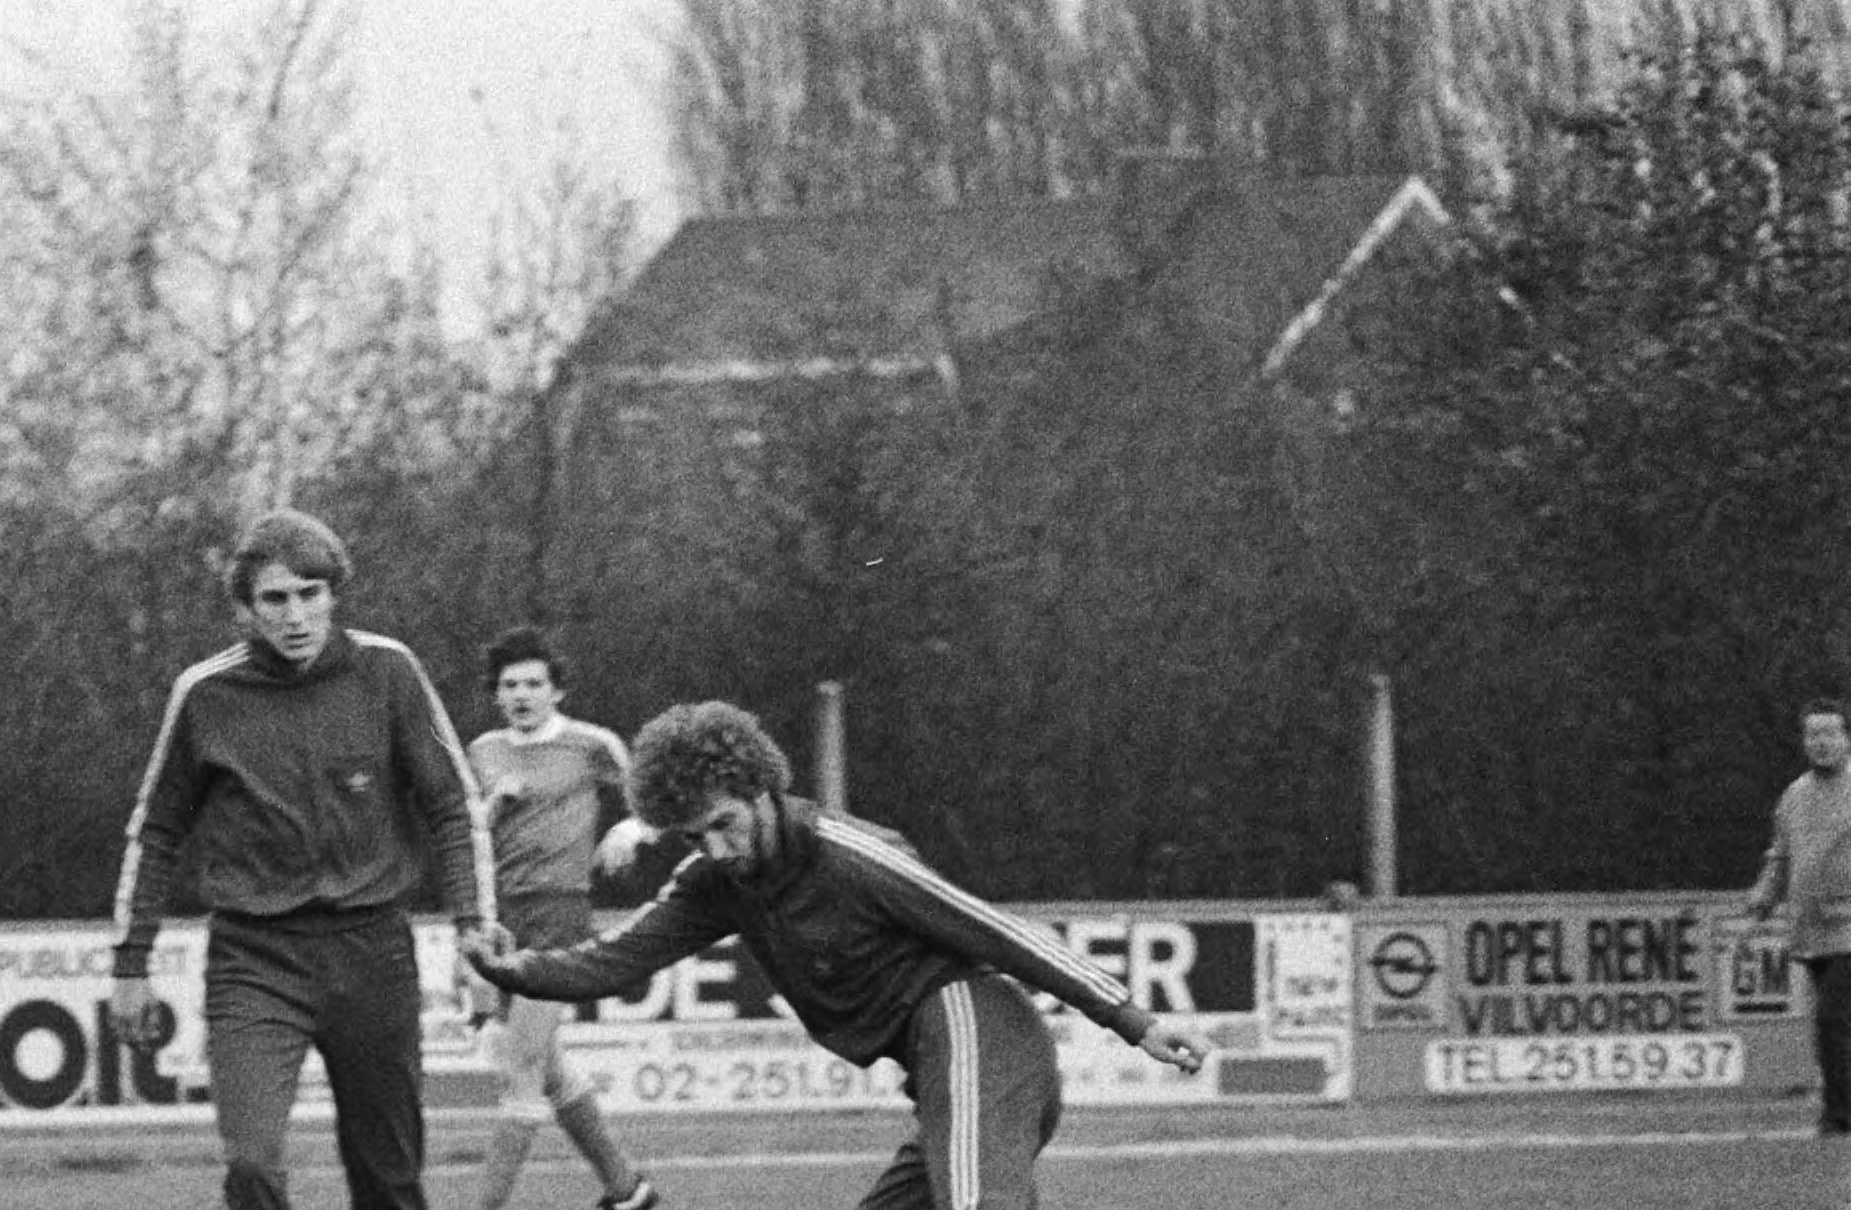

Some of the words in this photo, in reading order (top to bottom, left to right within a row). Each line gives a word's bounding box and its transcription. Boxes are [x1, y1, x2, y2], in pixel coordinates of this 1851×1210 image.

[1464, 920, 1573, 987] OPEL
[1732, 949, 1791, 996] GM
[1457, 990, 1706, 1036] VILVOORDE
